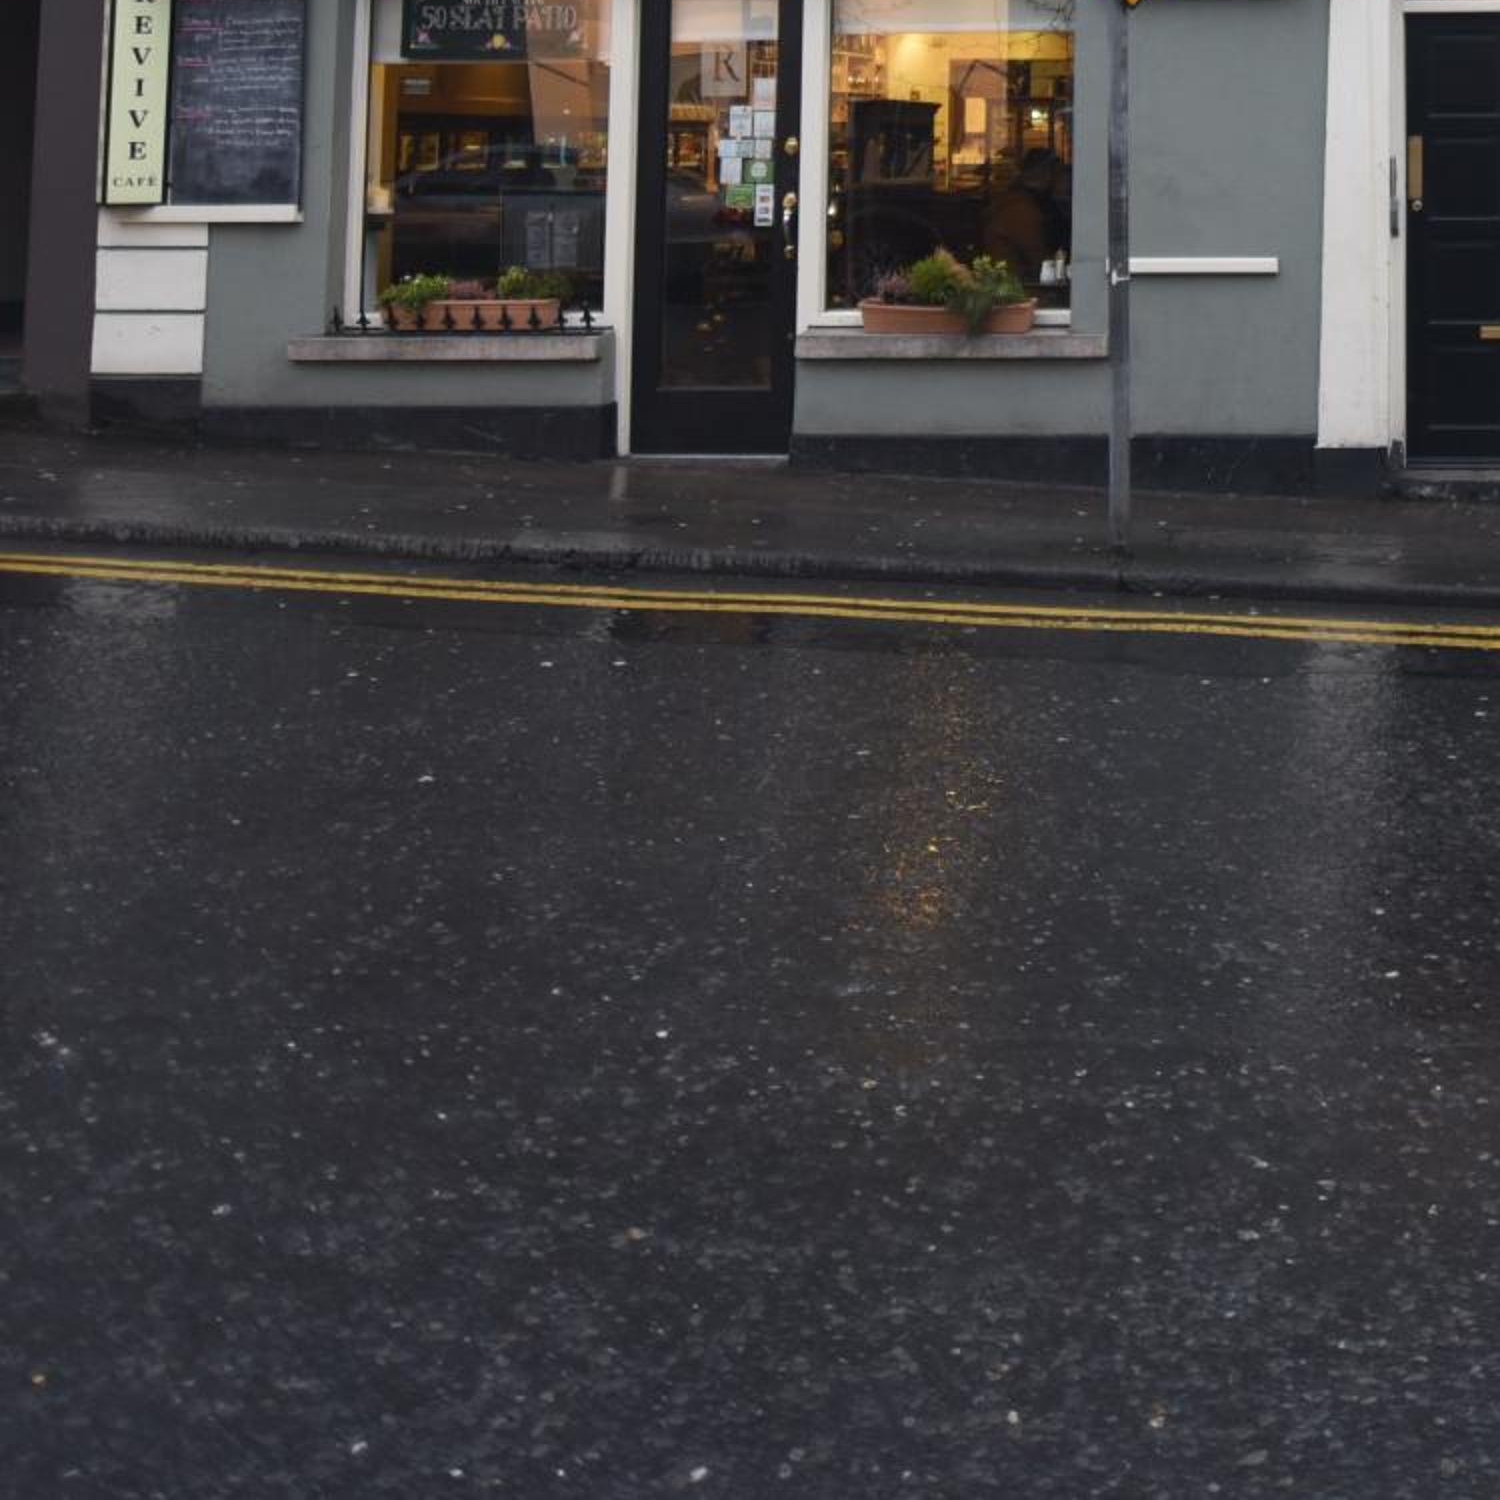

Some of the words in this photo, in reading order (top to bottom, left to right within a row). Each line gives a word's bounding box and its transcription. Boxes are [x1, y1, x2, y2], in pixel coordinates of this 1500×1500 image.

[420, 5, 448, 31] 50
[449, 4, 508, 31] SEAT
[512, 4, 578, 32] PATIO
[713, 45, 741, 83] R
